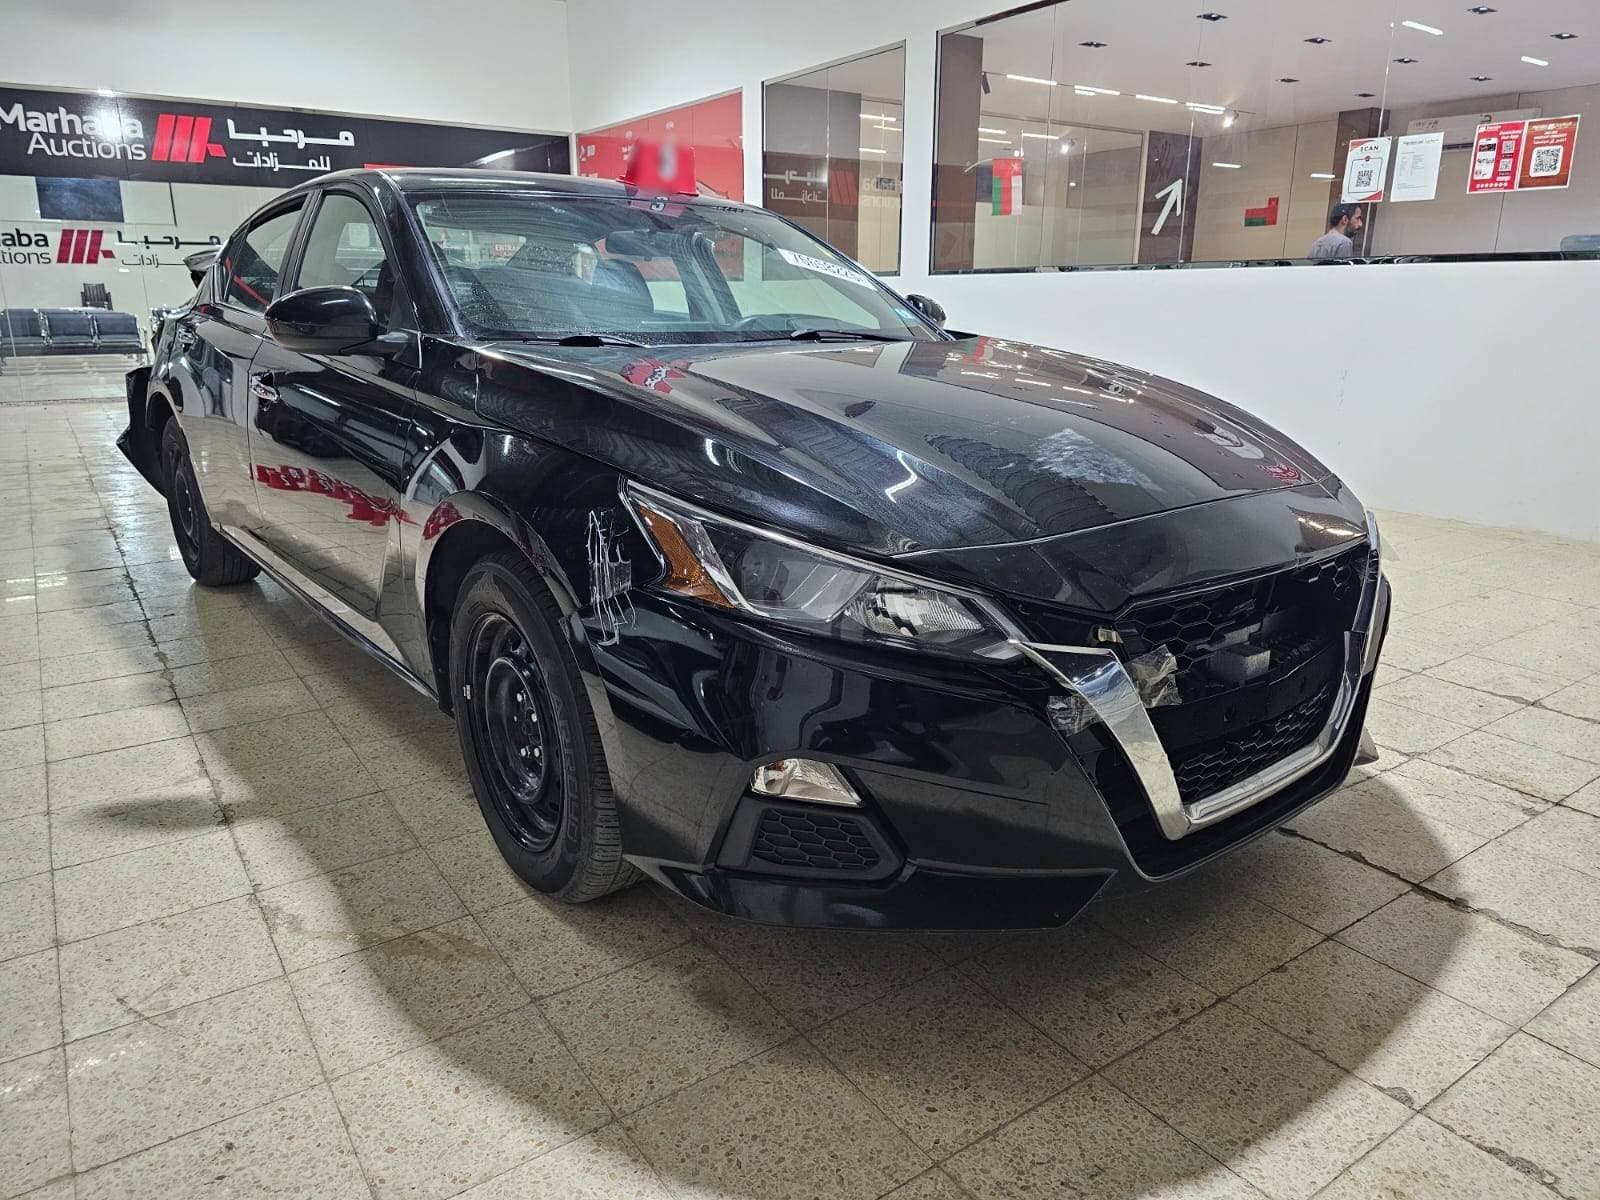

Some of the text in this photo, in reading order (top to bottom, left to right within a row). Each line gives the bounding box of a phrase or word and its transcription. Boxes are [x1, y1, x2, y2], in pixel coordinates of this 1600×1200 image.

[0, 103, 144, 139] Marhaa
[27, 132, 147, 161] Auctions
[227, 119, 355, 149] مرحبا
[232, 151, 331, 172] للمزادات
[0, 227, 49, 248] aba
[0, 247, 52, 264] tions
